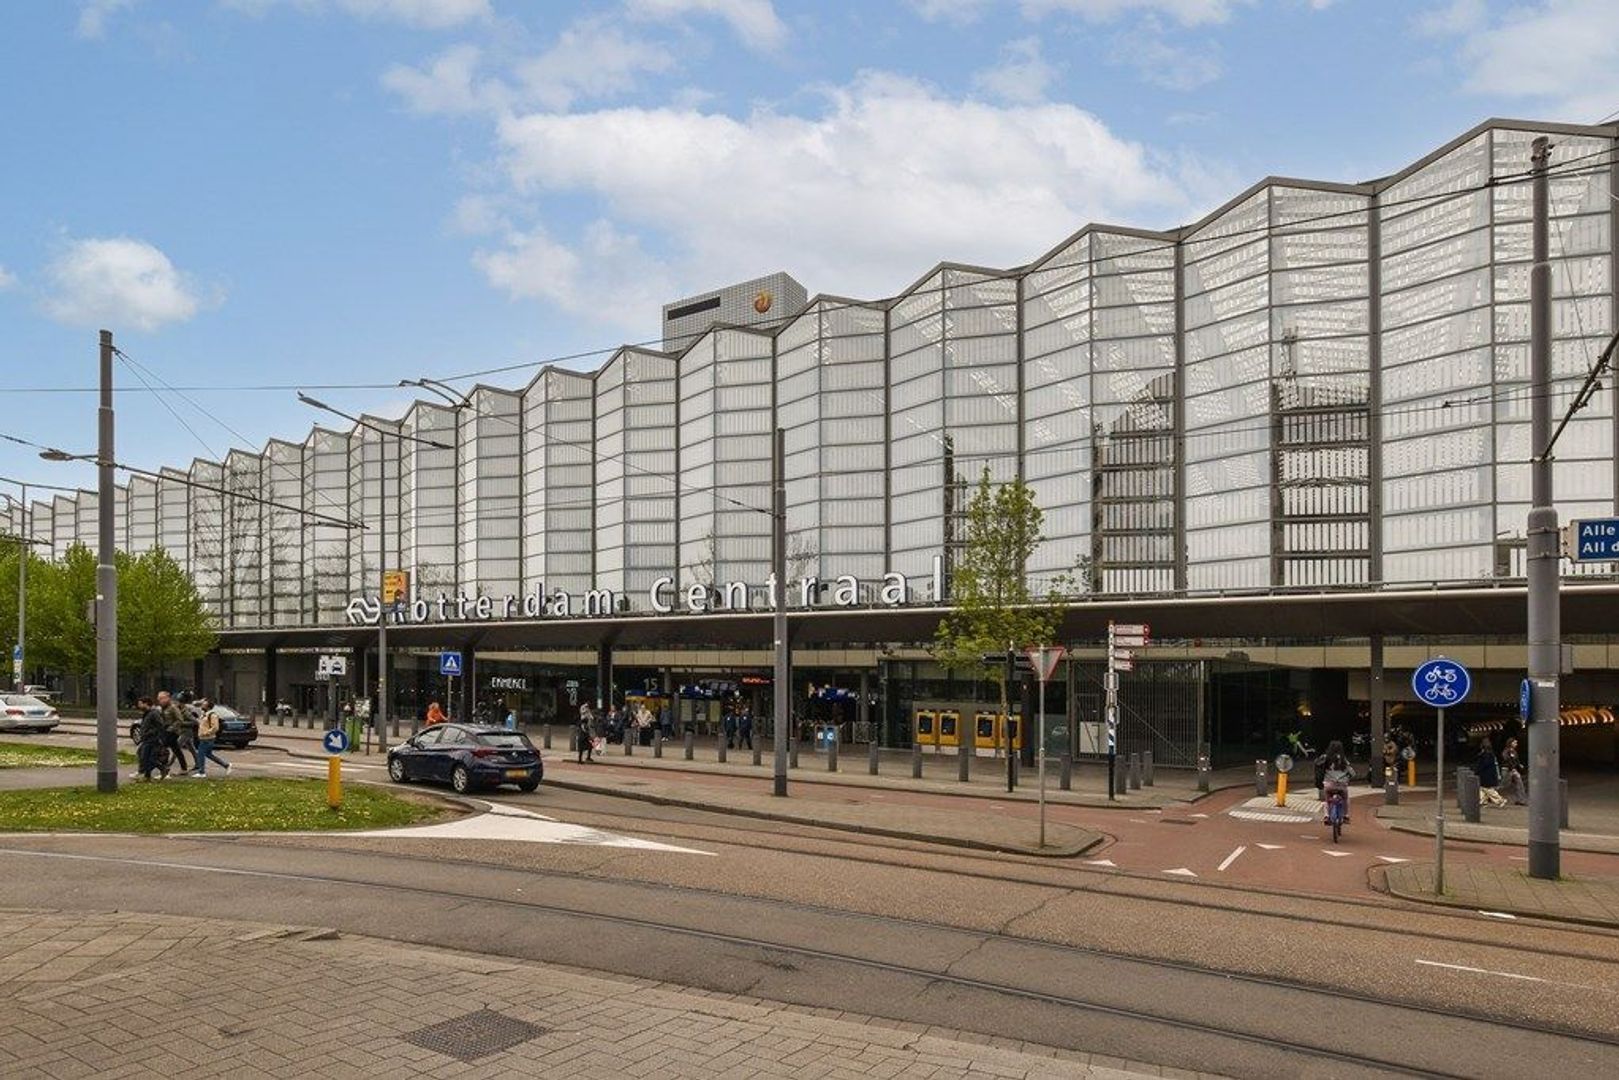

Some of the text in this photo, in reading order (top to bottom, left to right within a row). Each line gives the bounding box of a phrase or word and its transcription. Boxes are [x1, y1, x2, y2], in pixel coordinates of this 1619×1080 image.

[1583, 525, 1616, 536] Alle
[1583, 542, 1604, 553] All
[650, 555, 944, 612] Centraal
